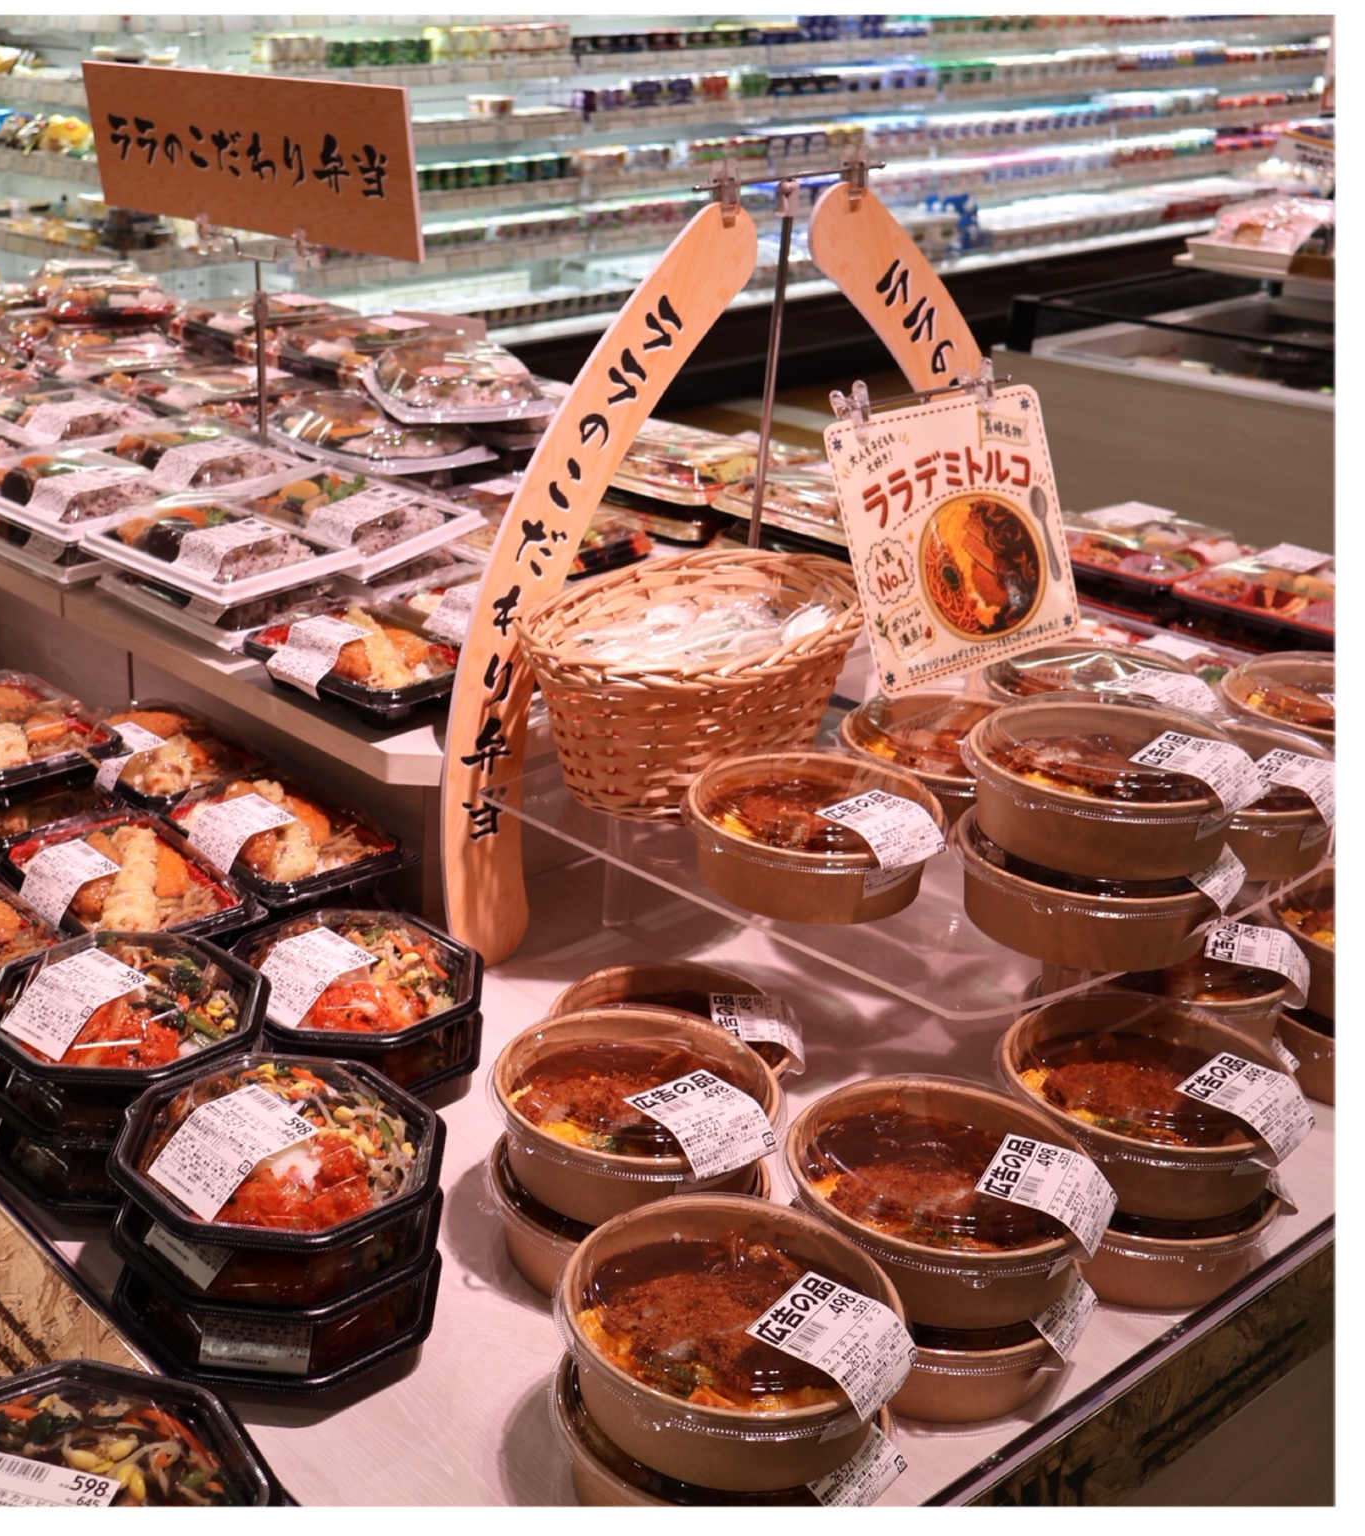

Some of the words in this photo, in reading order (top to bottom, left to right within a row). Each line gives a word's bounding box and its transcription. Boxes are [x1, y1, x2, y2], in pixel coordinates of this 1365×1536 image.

[107, 113, 388, 200] ララのこだわり弁当
[984, 416, 1023, 438] 長崎名物
[862, 446, 1032, 529] ララデミトルコ
[874, 547, 895, 569] 人気
[876, 558, 909, 596] No.1
[1137, 733, 1193, 766] 広告の品
[823, 790, 893, 821] 広告の品
[1181, 1056, 1248, 1102] 広告の品
[287, 1116, 313, 1137] 598
[977, 1134, 1037, 1202] 広告の品
[756, 1276, 837, 1345] 広告の品
[831, 1293, 857, 1318] 498
[71, 1474, 111, 1498] 598
